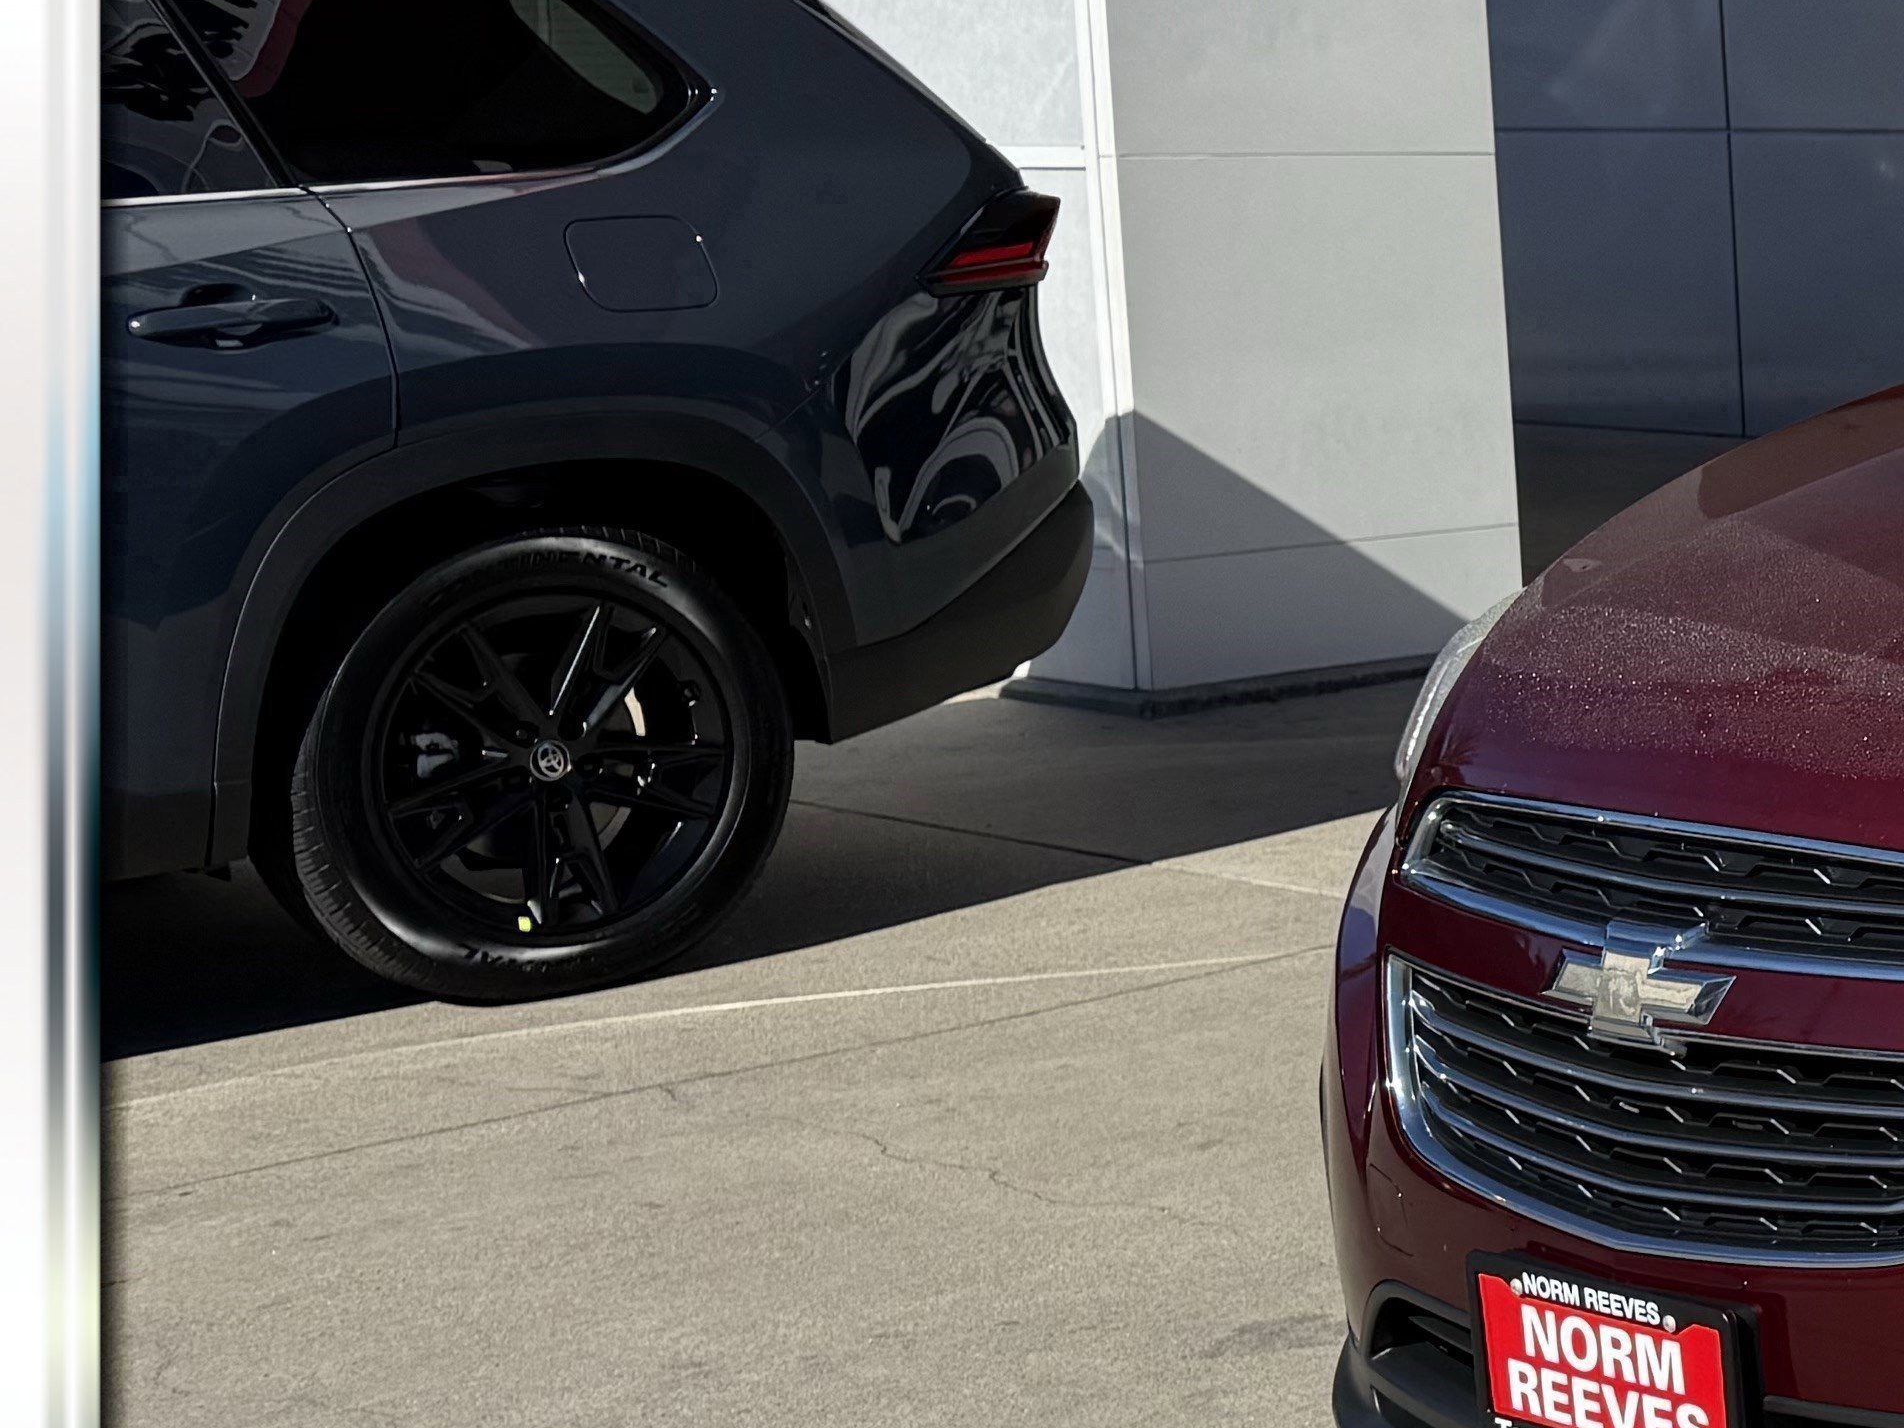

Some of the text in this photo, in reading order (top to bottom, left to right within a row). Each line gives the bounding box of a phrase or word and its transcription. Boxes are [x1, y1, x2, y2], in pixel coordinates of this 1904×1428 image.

[1522, 1272, 1661, 1326] NORM REEVES
[1520, 1303, 1686, 1395] NORM
